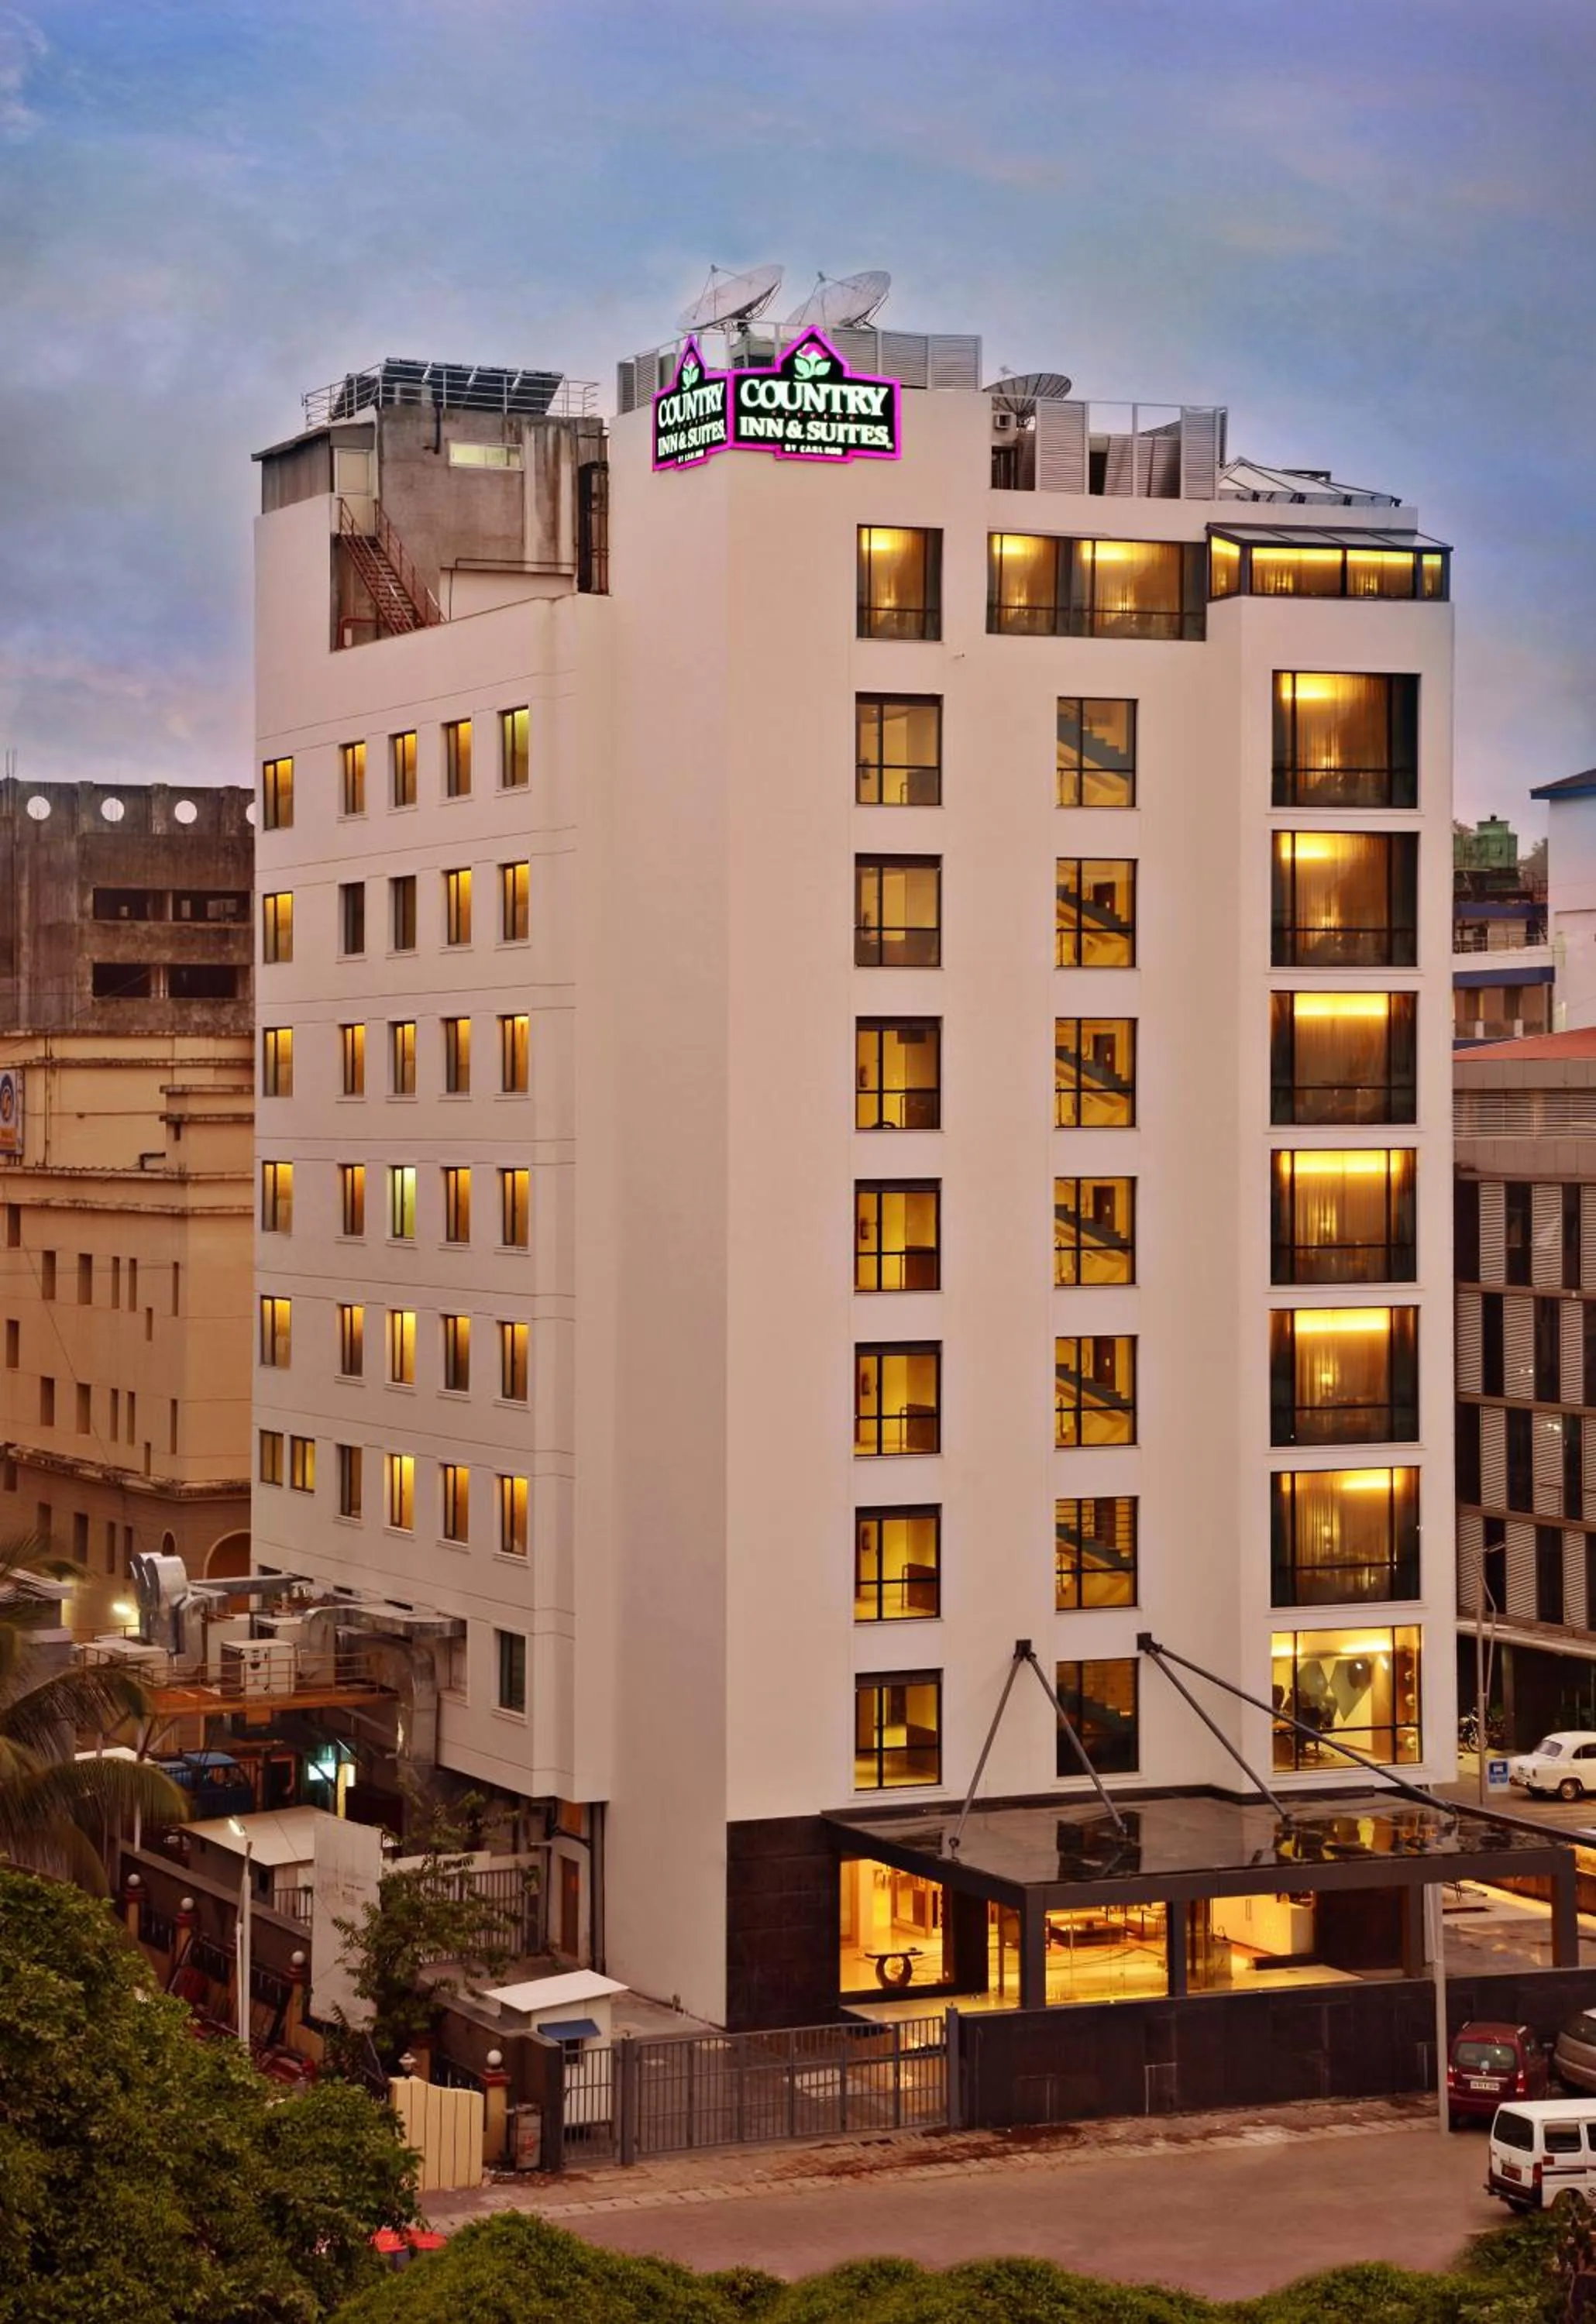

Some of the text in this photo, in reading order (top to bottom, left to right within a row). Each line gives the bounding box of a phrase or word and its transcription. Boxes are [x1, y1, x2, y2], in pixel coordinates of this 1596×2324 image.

[658, 382, 725, 428] COUNTRY
[739, 379, 889, 416] COUNTRY
[658, 432, 678, 457] INN
[679, 431, 686, 449] &
[739, 416, 889, 445] INN & SUITES
